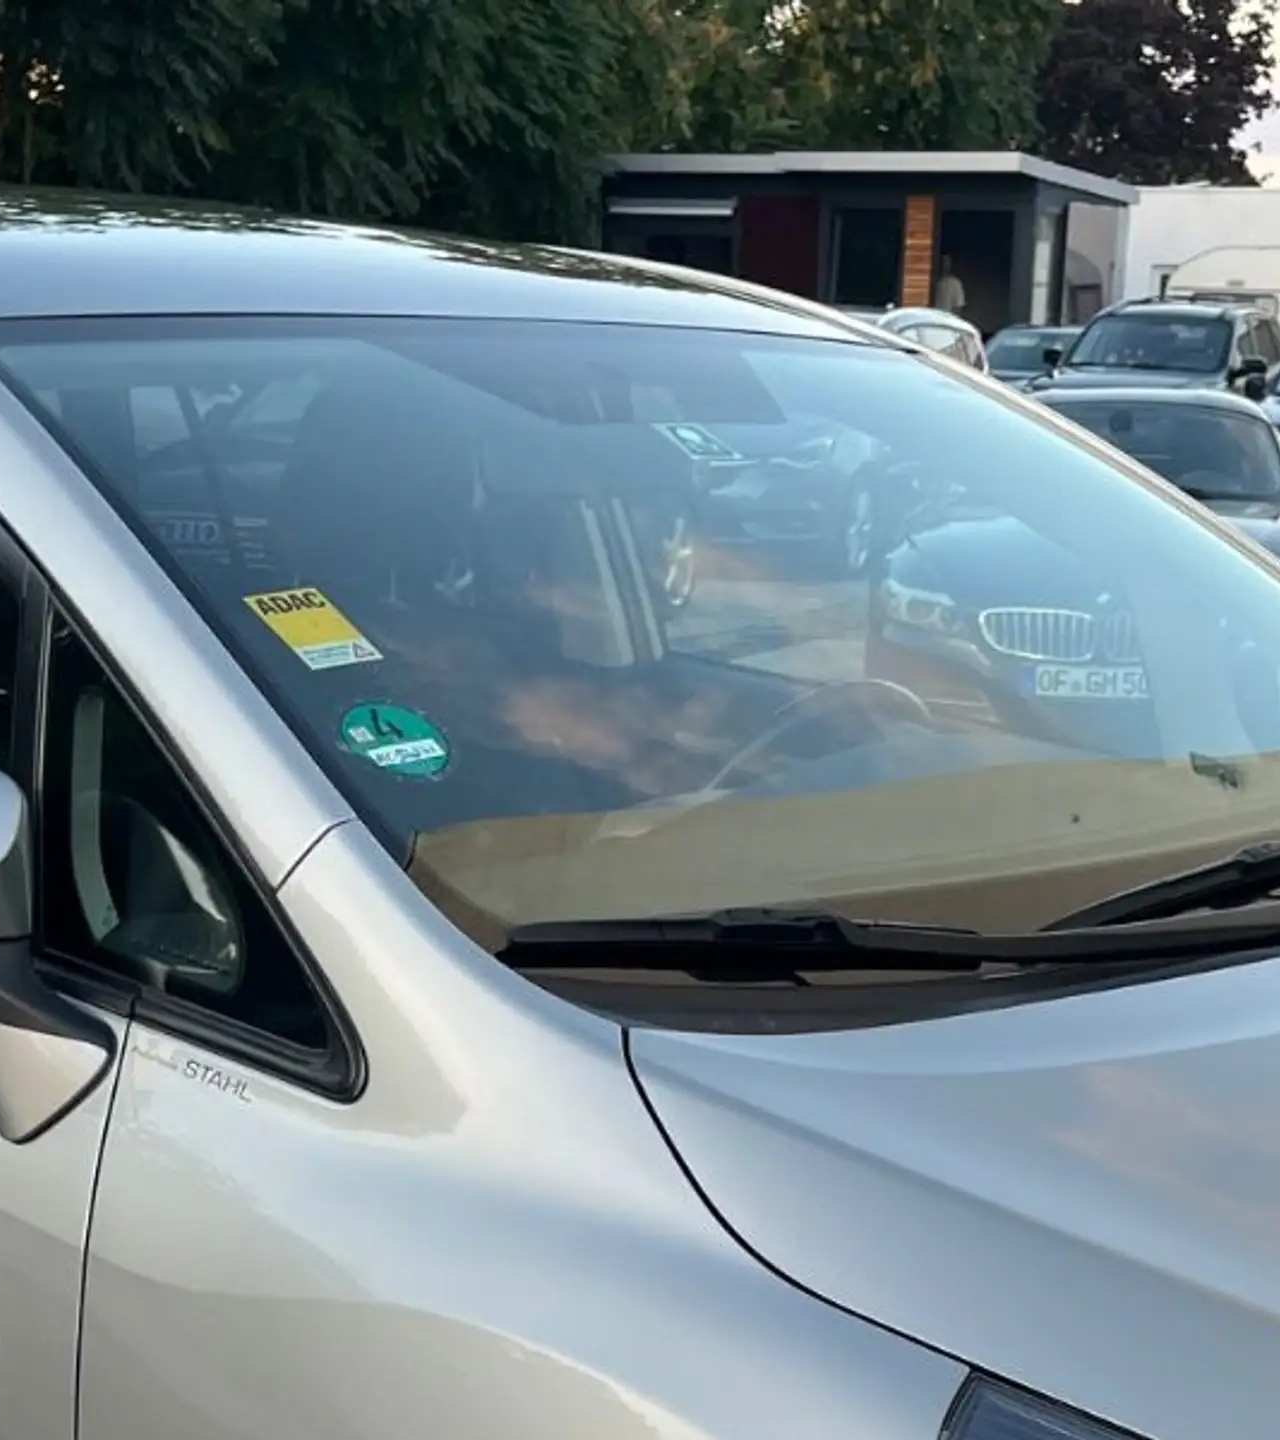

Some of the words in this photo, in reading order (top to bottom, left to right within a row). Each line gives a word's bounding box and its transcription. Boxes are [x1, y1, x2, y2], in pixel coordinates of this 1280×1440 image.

[255, 590, 326, 616] ADAC
[368, 708, 404, 739] 4
[183, 1059, 253, 1104] STAHL
